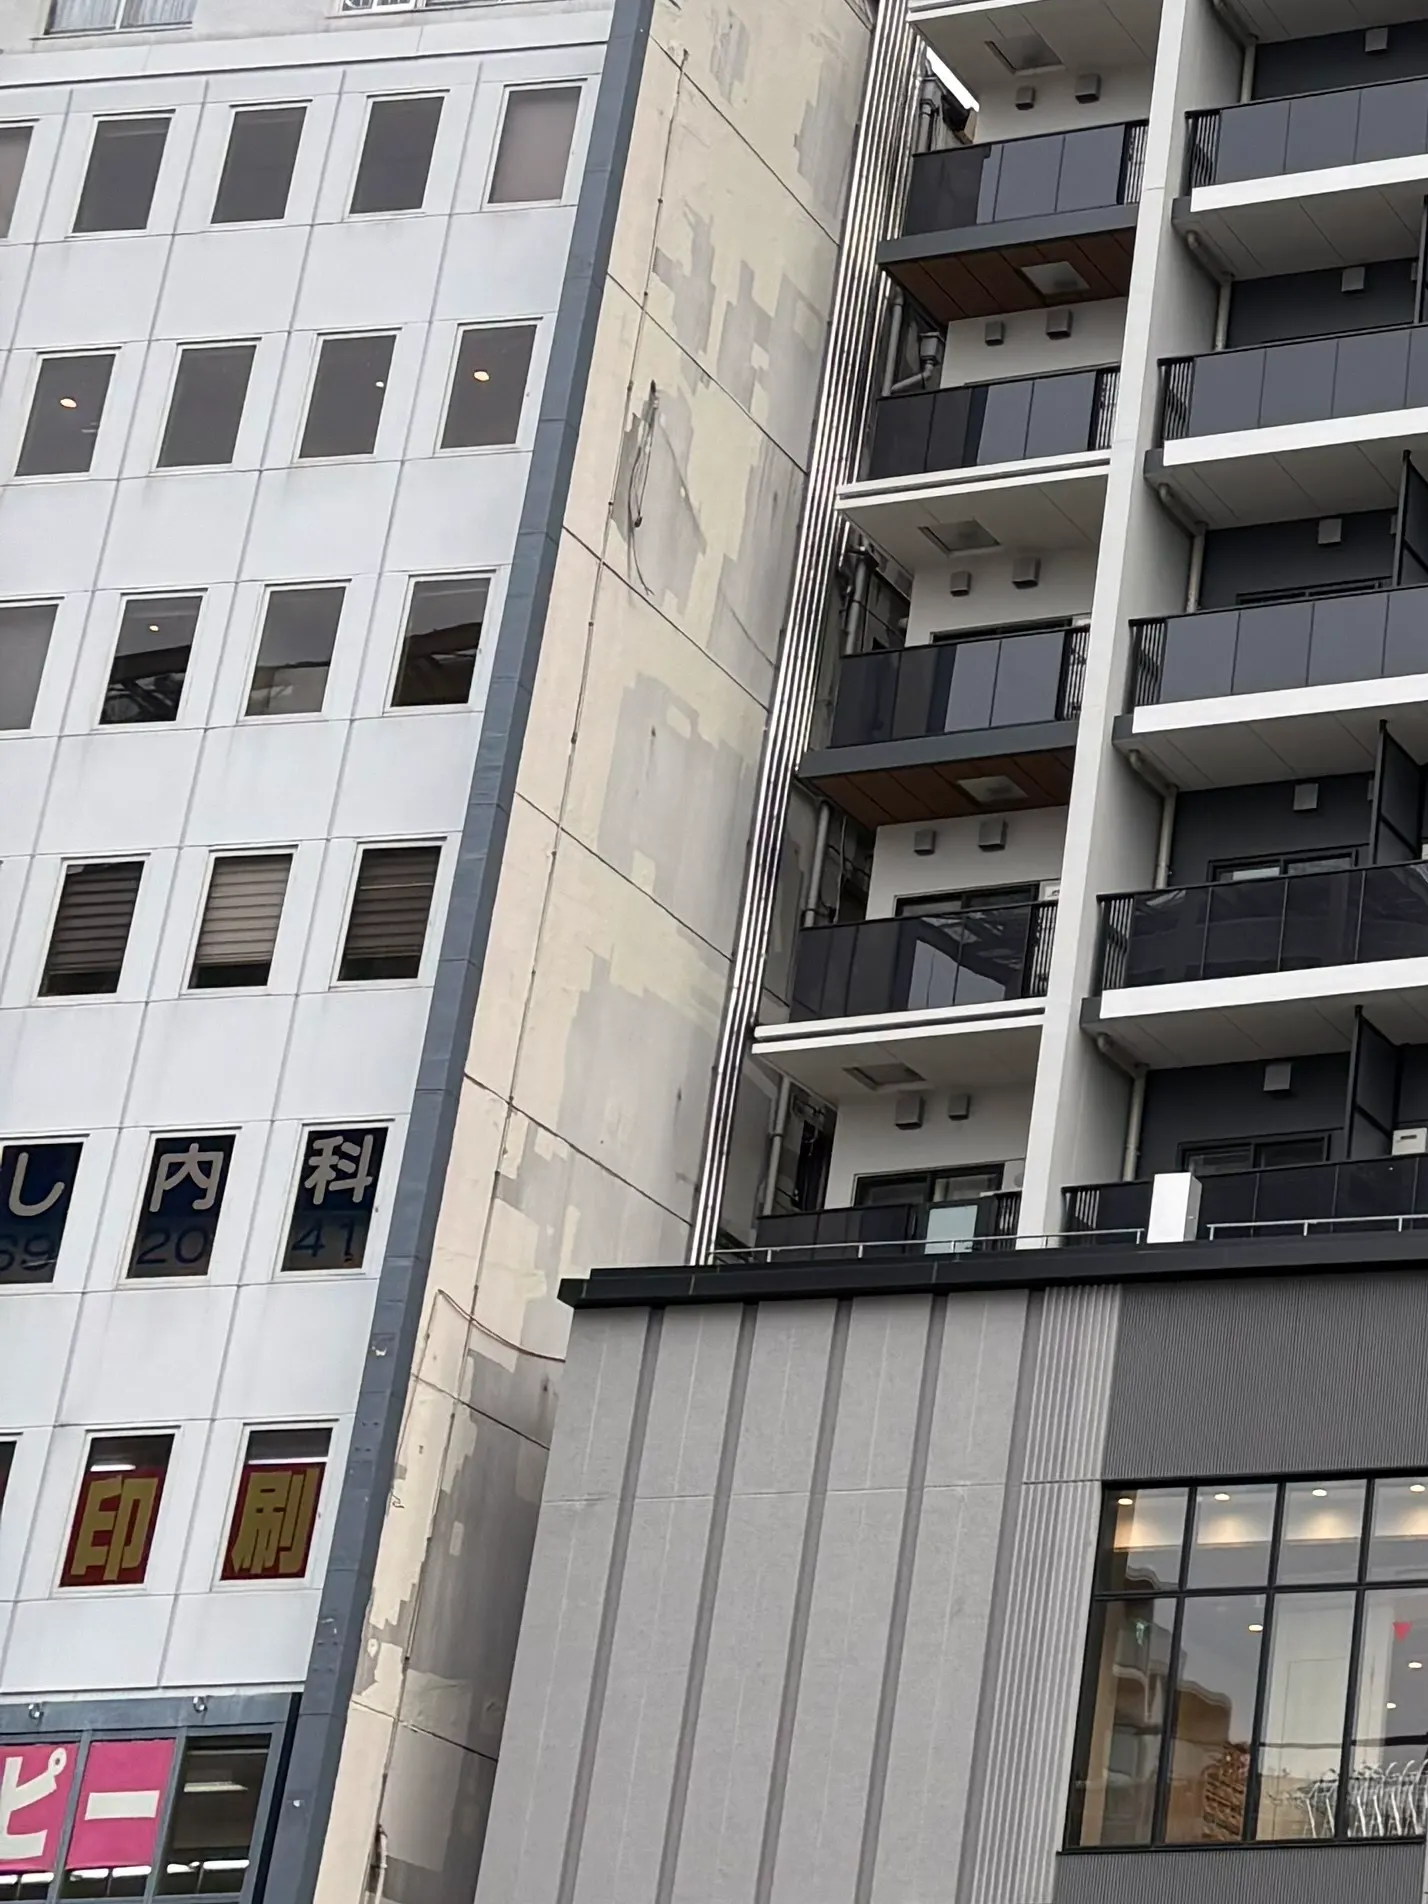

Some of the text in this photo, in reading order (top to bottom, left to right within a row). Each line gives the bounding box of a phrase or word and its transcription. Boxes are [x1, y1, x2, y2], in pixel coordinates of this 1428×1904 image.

[136, 1224, 210, 1266] 20
[291, 1216, 356, 1260] 41
[70, 1468, 316, 1580] 印刷
